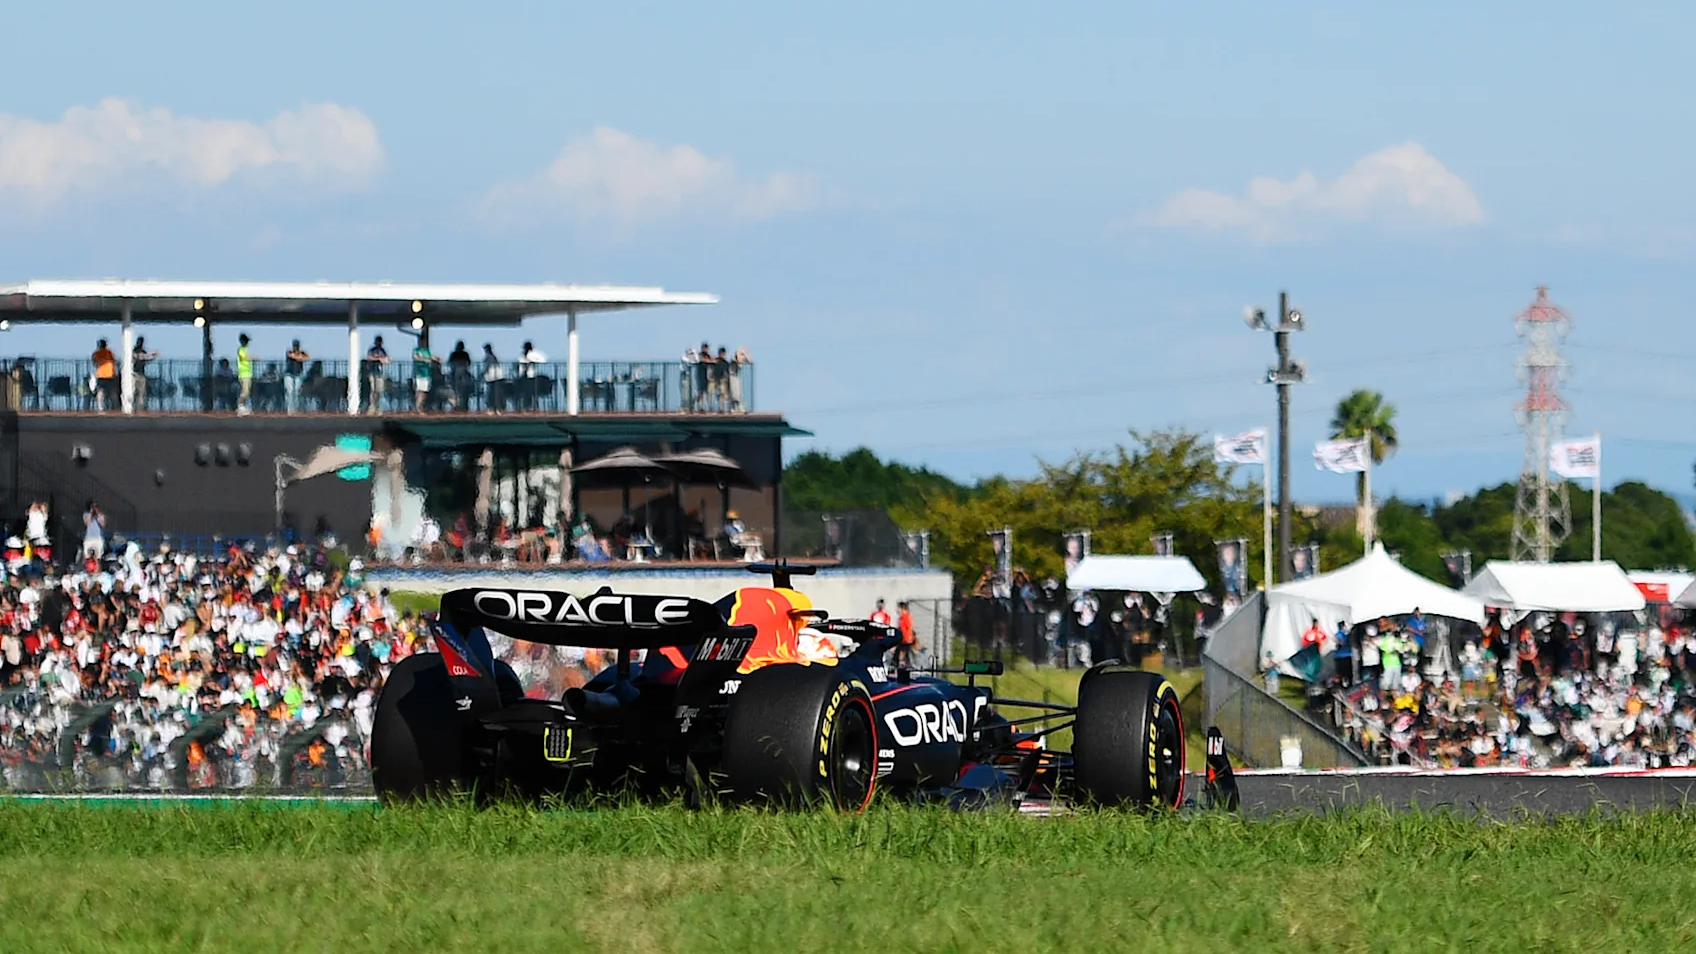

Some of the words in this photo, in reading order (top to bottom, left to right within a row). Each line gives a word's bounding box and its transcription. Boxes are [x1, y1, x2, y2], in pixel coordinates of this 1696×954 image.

[474, 590, 693, 626] ORACLE
[697, 637, 740, 661] Mobil
[819, 690, 841, 755] ZERO
[818, 761, 828, 778] P
[1148, 722, 1158, 790] ZERO
